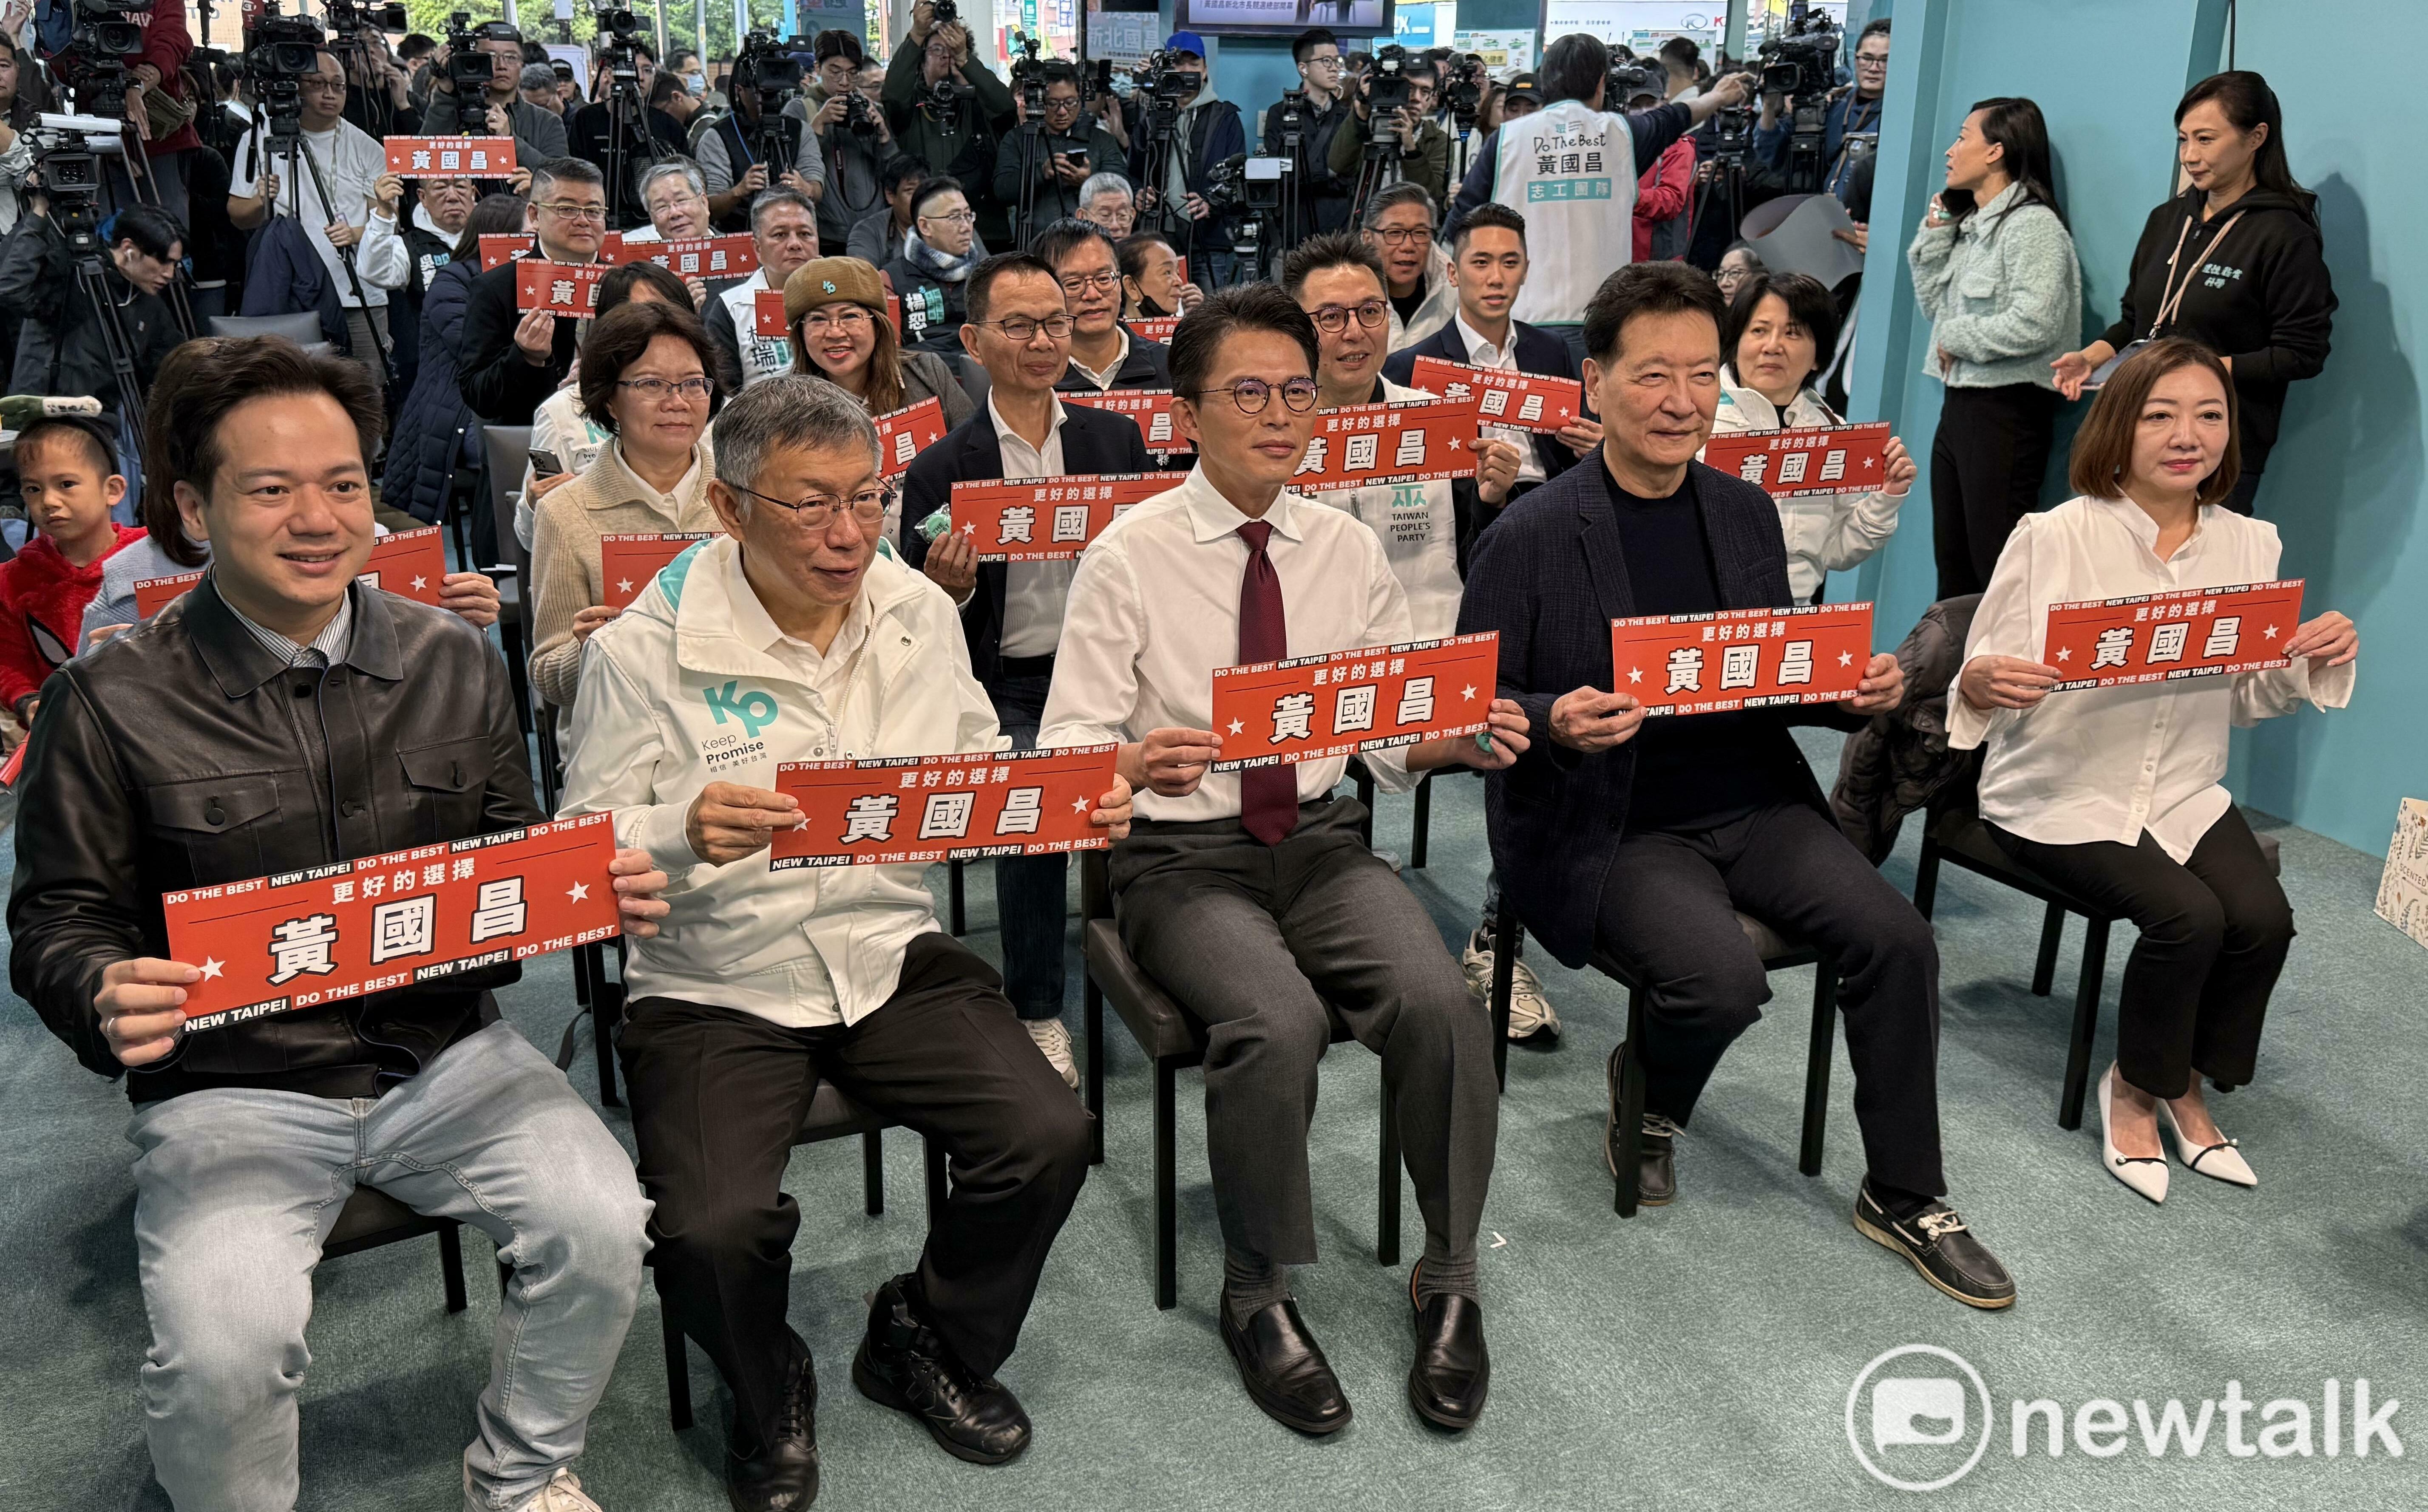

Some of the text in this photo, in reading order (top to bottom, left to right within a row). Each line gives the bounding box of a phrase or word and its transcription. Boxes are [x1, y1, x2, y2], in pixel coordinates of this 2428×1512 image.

[1534, 133, 1606, 154] Do The Best
[411, 150, 487, 169] 黃國昌
[1537, 152, 1602, 175] 黃國昌
[1472, 373, 1528, 390] 更好的選擇
[1326, 413, 1400, 432] 更好的選擇
[1768, 435, 1829, 450] 更好的選擇
[1339, 479, 1361, 487] BEST
[1365, 477, 1385, 485] NEW
[1387, 474, 1414, 483] TAIPEI
[1433, 470, 1449, 479] THE
[1452, 468, 1474, 477] BEST
[1737, 450, 1846, 486] 黃國昌
[1034, 486, 1112, 501] 更好的選擇
[1390, 522, 1431, 532] PEOPLE'S
[1392, 512, 1428, 521] TAIWAN
[383, 527, 438, 544] DO THE BEST
[1397, 533, 1426, 542] PARTY
[136, 572, 202, 589] DO THE BEST
[2134, 600, 2216, 621] 更好的選擇
[1702, 621, 1784, 642] 更好的選擇
[2092, 617, 2240, 668] 黃國昌
[1231, 666, 1248, 675] THE
[1251, 663, 1274, 672] BEST
[1278, 660, 1298, 669] NEW
[1299, 655, 1327, 665] TAIPEI
[1345, 650, 1361, 659] THE
[1364, 647, 1386, 657] BEST
[1391, 644, 1410, 653] NEW
[1412, 640, 1438, 650] TAIPEI
[1457, 636, 1472, 644] THE
[1475, 633, 1495, 642] BEST
[1313, 658, 1404, 686] 更好的選擇
[1665, 641, 1811, 692] 黃國昌
[2066, 679, 2096, 689] TAIPEI
[2117, 675, 2136, 683] THE
[2138, 672, 2164, 682] BEST
[2168, 669, 2190, 678] NEW
[2192, 665, 2222, 676] TAIPEI
[2226, 664, 2240, 672] DO
[2243, 661, 2261, 670] THE
[2263, 658, 2288, 668] BEST
[1271, 677, 1433, 742] 黃國昌
[1678, 705, 1692, 713] DO
[1694, 702, 1713, 711] THE
[1715, 700, 1740, 709] BEST
[1744, 697, 1766, 706] NEW
[1768, 694, 1798, 705] TAIPEI
[1803, 693, 1817, 702] DO
[1819, 691, 1838, 700] THE
[1841, 690, 1860, 698] BES
[702, 734, 736, 751] Keep
[706, 741, 764, 765] Promise
[899, 767, 1010, 788] 更好的選擇
[842, 788, 1041, 843] 黃國昌
[167, 813, 608, 904] DO THE BEST NEW TAIPEI DO THE BEST NEW TAIPEI DO THE BEST
[771, 838, 1105, 868] NEW TAIPEI DO THE BEST NEW TAIPEI DO THE BEST
[332, 857, 474, 904] 更好的選擇
[2399, 863, 2426, 887] SCENTED
[271, 878, 525, 983] 黃國昌
